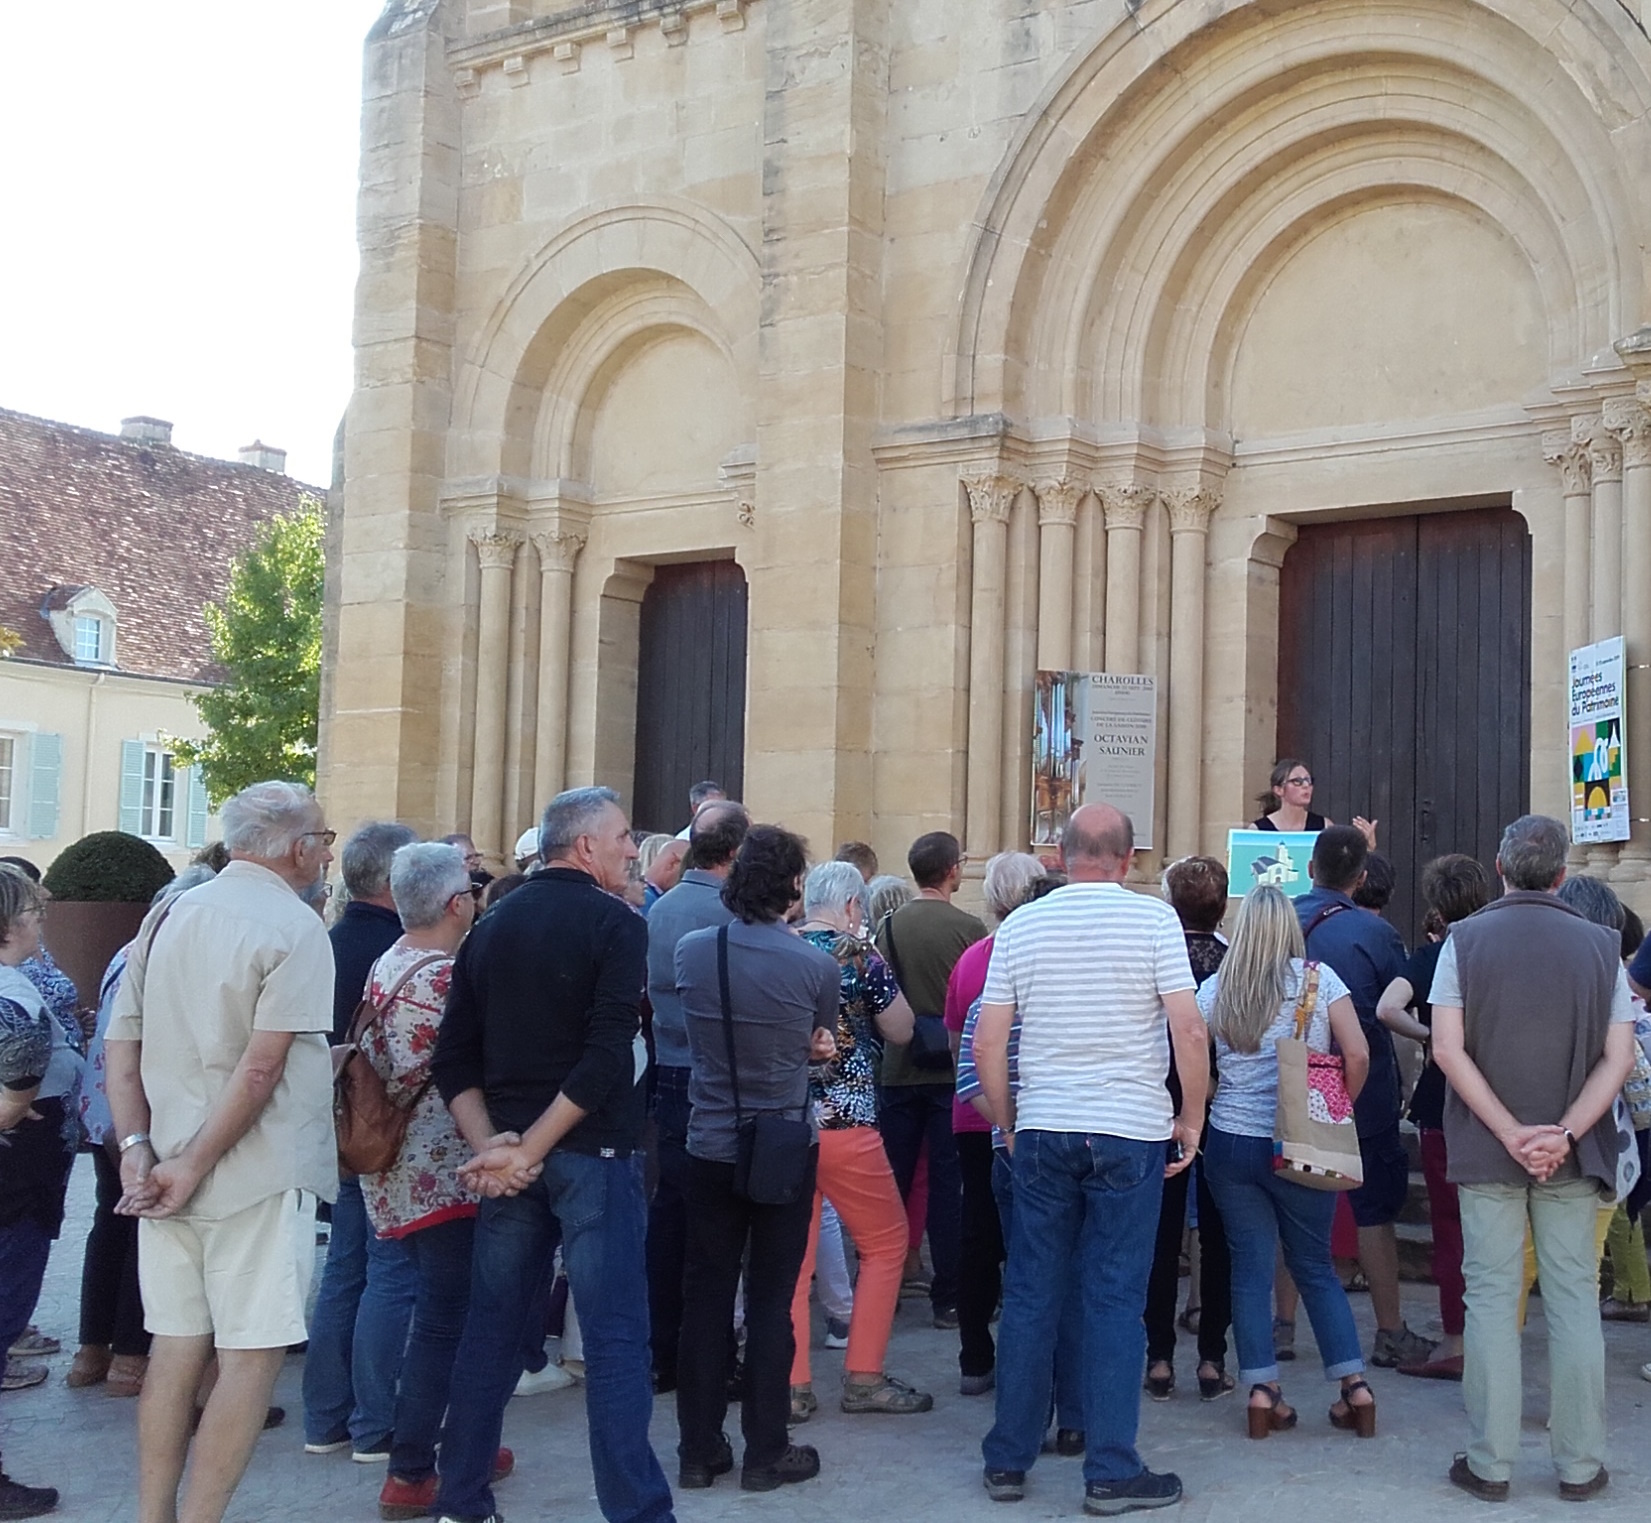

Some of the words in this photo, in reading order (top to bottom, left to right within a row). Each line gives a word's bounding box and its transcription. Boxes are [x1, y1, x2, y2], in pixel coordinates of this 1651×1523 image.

[1092, 675, 1154, 685] CHAROLLES
[1572, 671, 1603, 688] Journées
[1572, 682, 1616, 702] Européennes
[1571, 702, 1580, 716] du
[1581, 696, 1619, 714] Patrimoine
[1094, 733, 1148, 744] OCTAVIAN
[1099, 746, 1145, 756] SAUNIER
